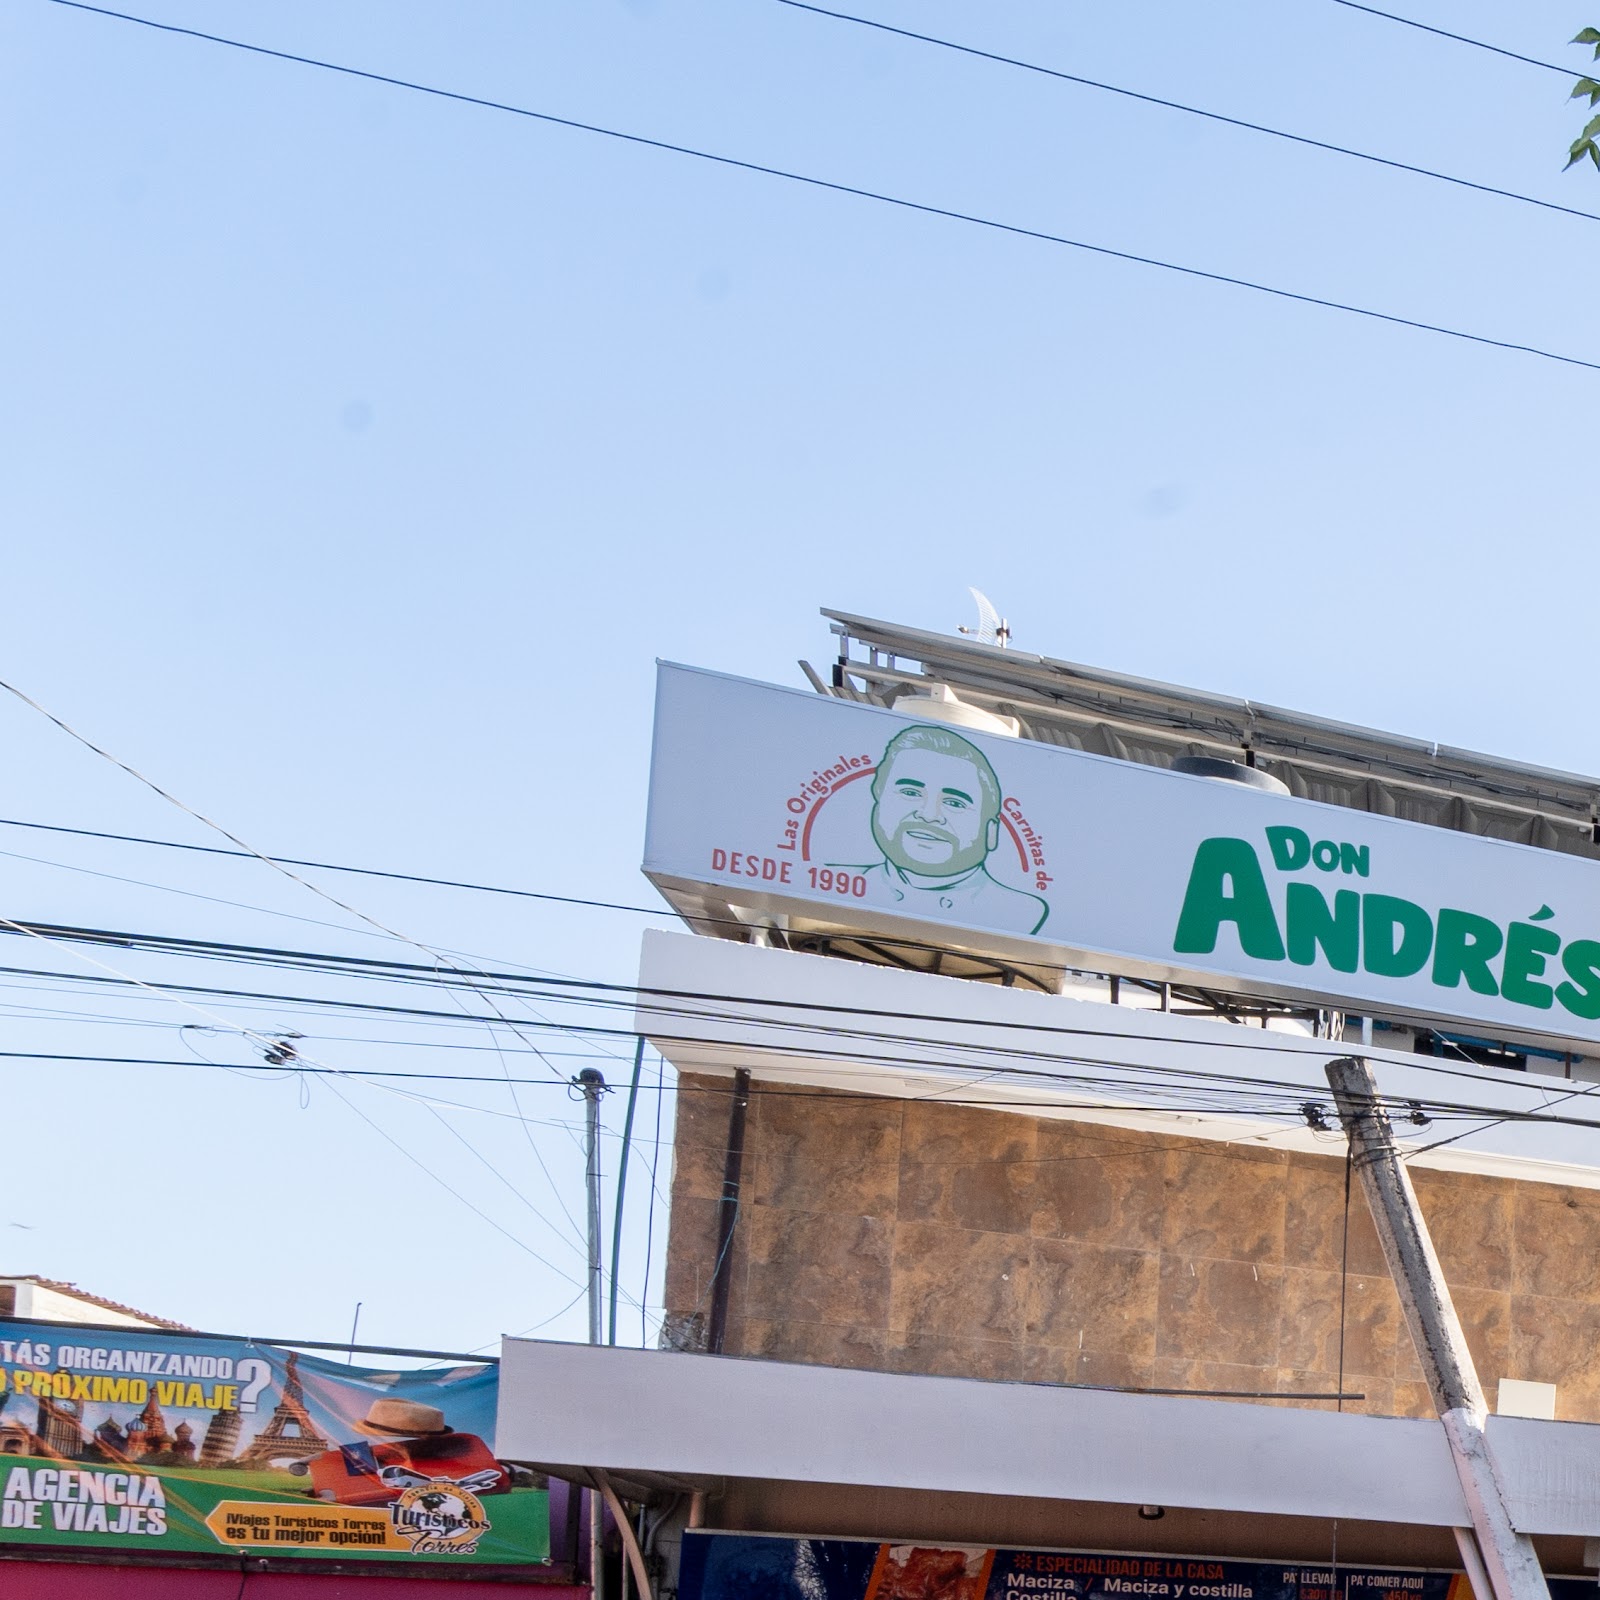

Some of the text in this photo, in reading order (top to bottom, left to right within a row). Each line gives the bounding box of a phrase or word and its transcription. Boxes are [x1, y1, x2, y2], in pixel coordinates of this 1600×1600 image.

[776, 753, 874, 851] Las Originales
[1001, 795, 1052, 871] Carnitas
[1263, 824, 1371, 880] DON
[710, 847, 868, 899] DESDE 1990
[57, 1345, 234, 1380] ORGANIZANDO
[13, 1368, 240, 1411] PRÓXIMO VIAJE
[3, 1466, 167, 1507] AGENCIA
[0, 1499, 169, 1536] DE VIAJES
[226, 1526, 247, 1540] es
[251, 1526, 270, 1541] tu
[275, 1528, 325, 1545] mejor
[342, 1517, 386, 1532] Torres
[395, 1526, 479, 1555] Torres
[1007, 1573, 1253, 1598] Maciza Maciza costilla
[1036, 1555, 1224, 1580] ESPECIALIDAD DE LA CASA
[1367, 1575, 1400, 1588] COMER
